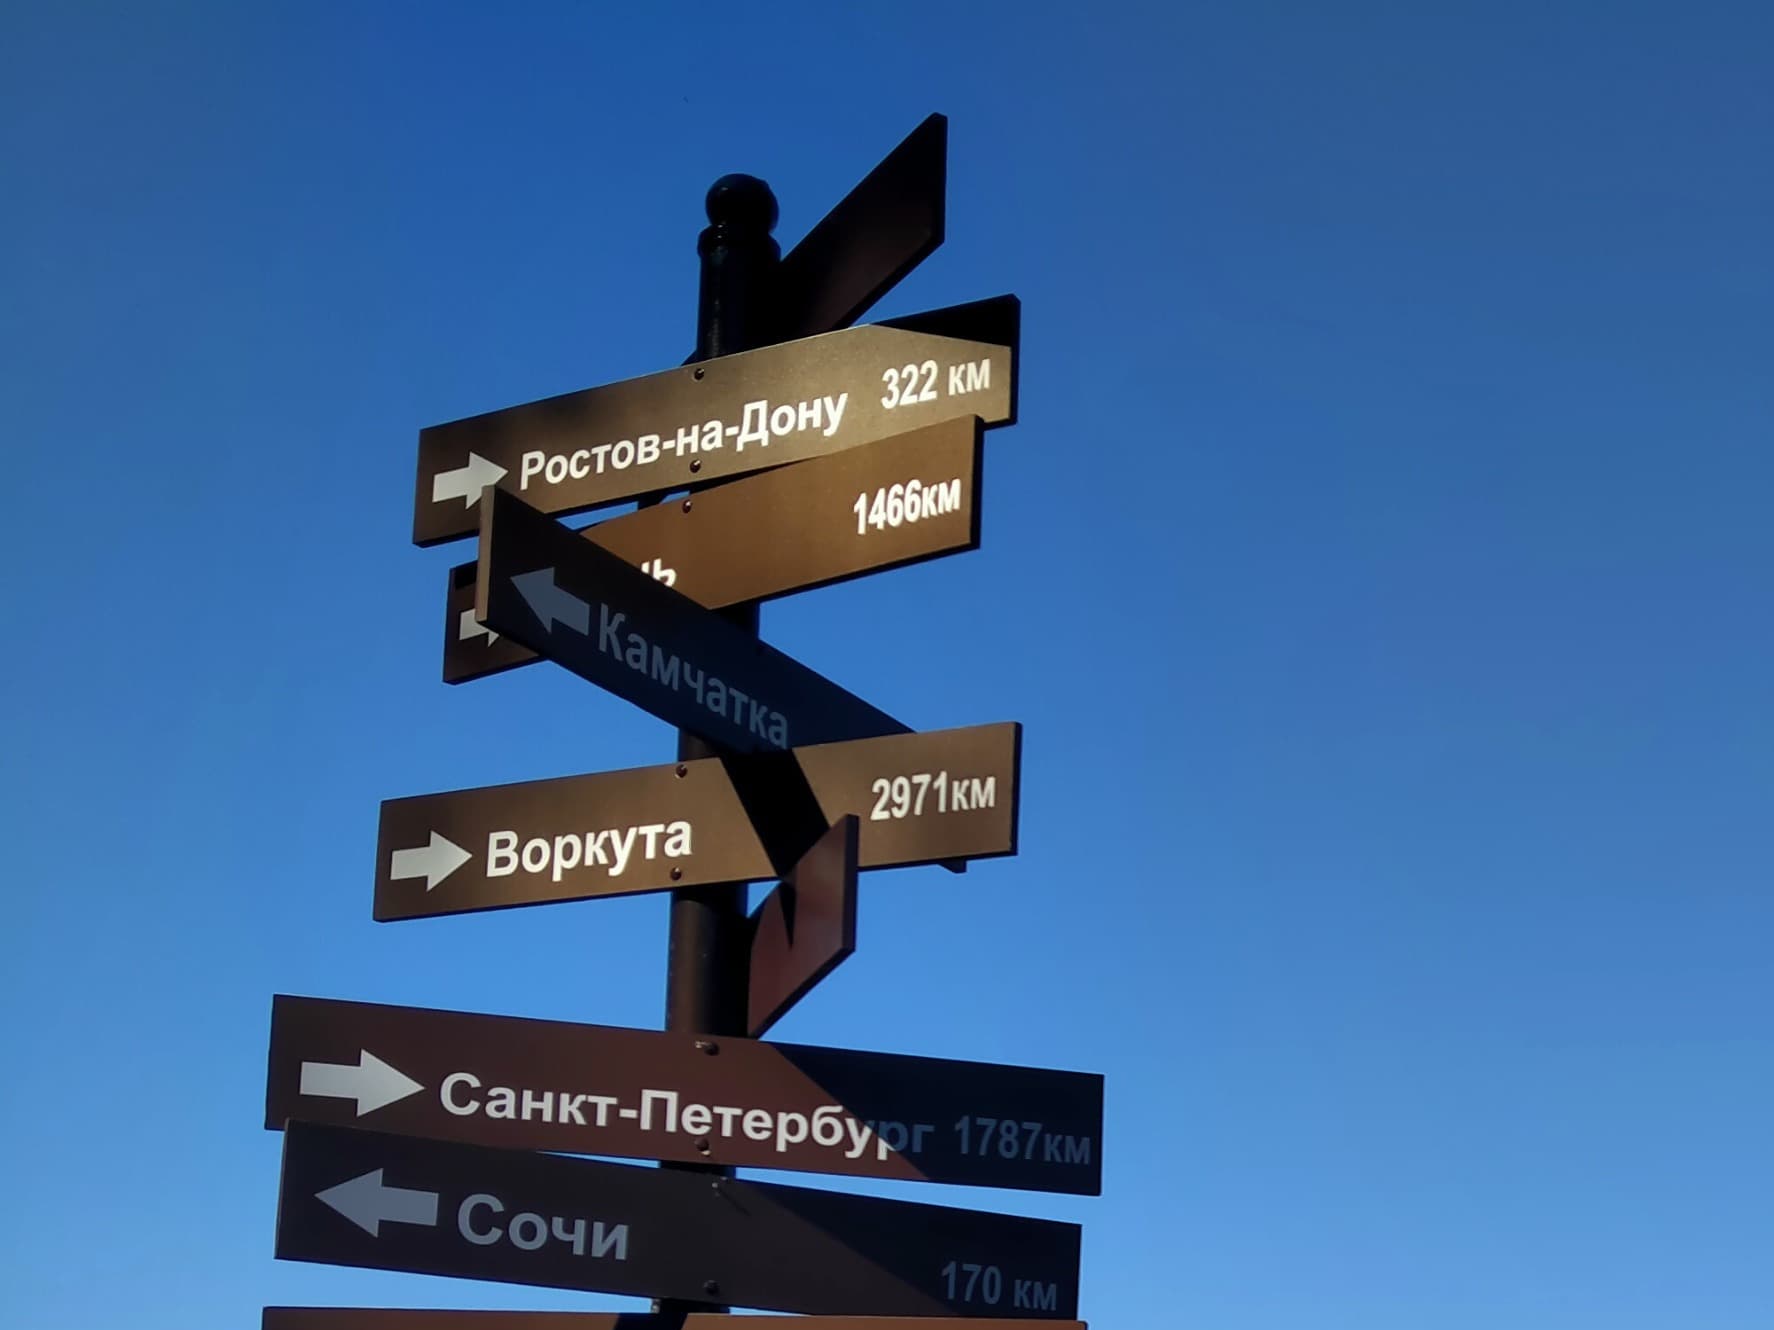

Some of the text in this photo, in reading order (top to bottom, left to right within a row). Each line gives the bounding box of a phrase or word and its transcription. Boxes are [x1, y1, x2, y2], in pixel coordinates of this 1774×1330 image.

[520, 358, 991, 490] Ростов-на-Дону 322 км
[853, 479, 961, 535] 1466км
[598, 603, 790, 750] Камчатка
[486, 771, 996, 881] Воркута 2971км
[439, 1072, 1091, 1165] Санкт-Петербург 1787км
[457, 1193, 1057, 1311] Сочи 170 км
